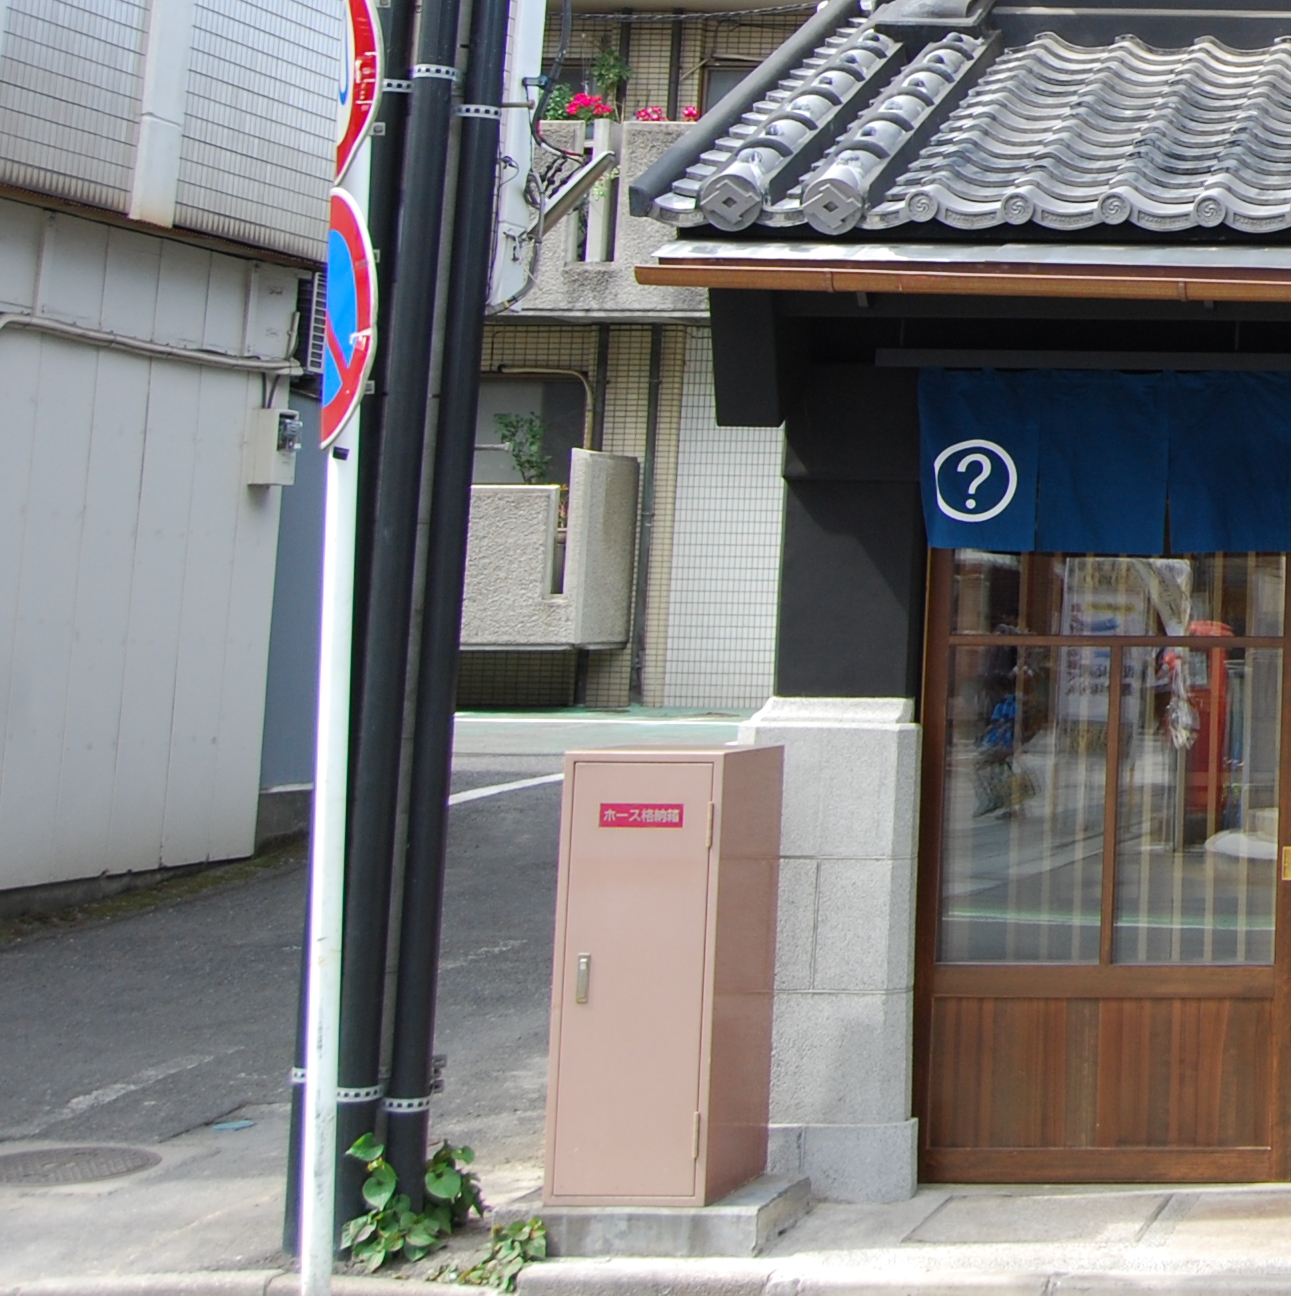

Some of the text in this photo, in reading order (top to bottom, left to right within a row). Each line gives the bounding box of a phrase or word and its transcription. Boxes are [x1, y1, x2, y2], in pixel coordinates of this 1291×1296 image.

[603, 808, 680, 823] ホース格納箱
